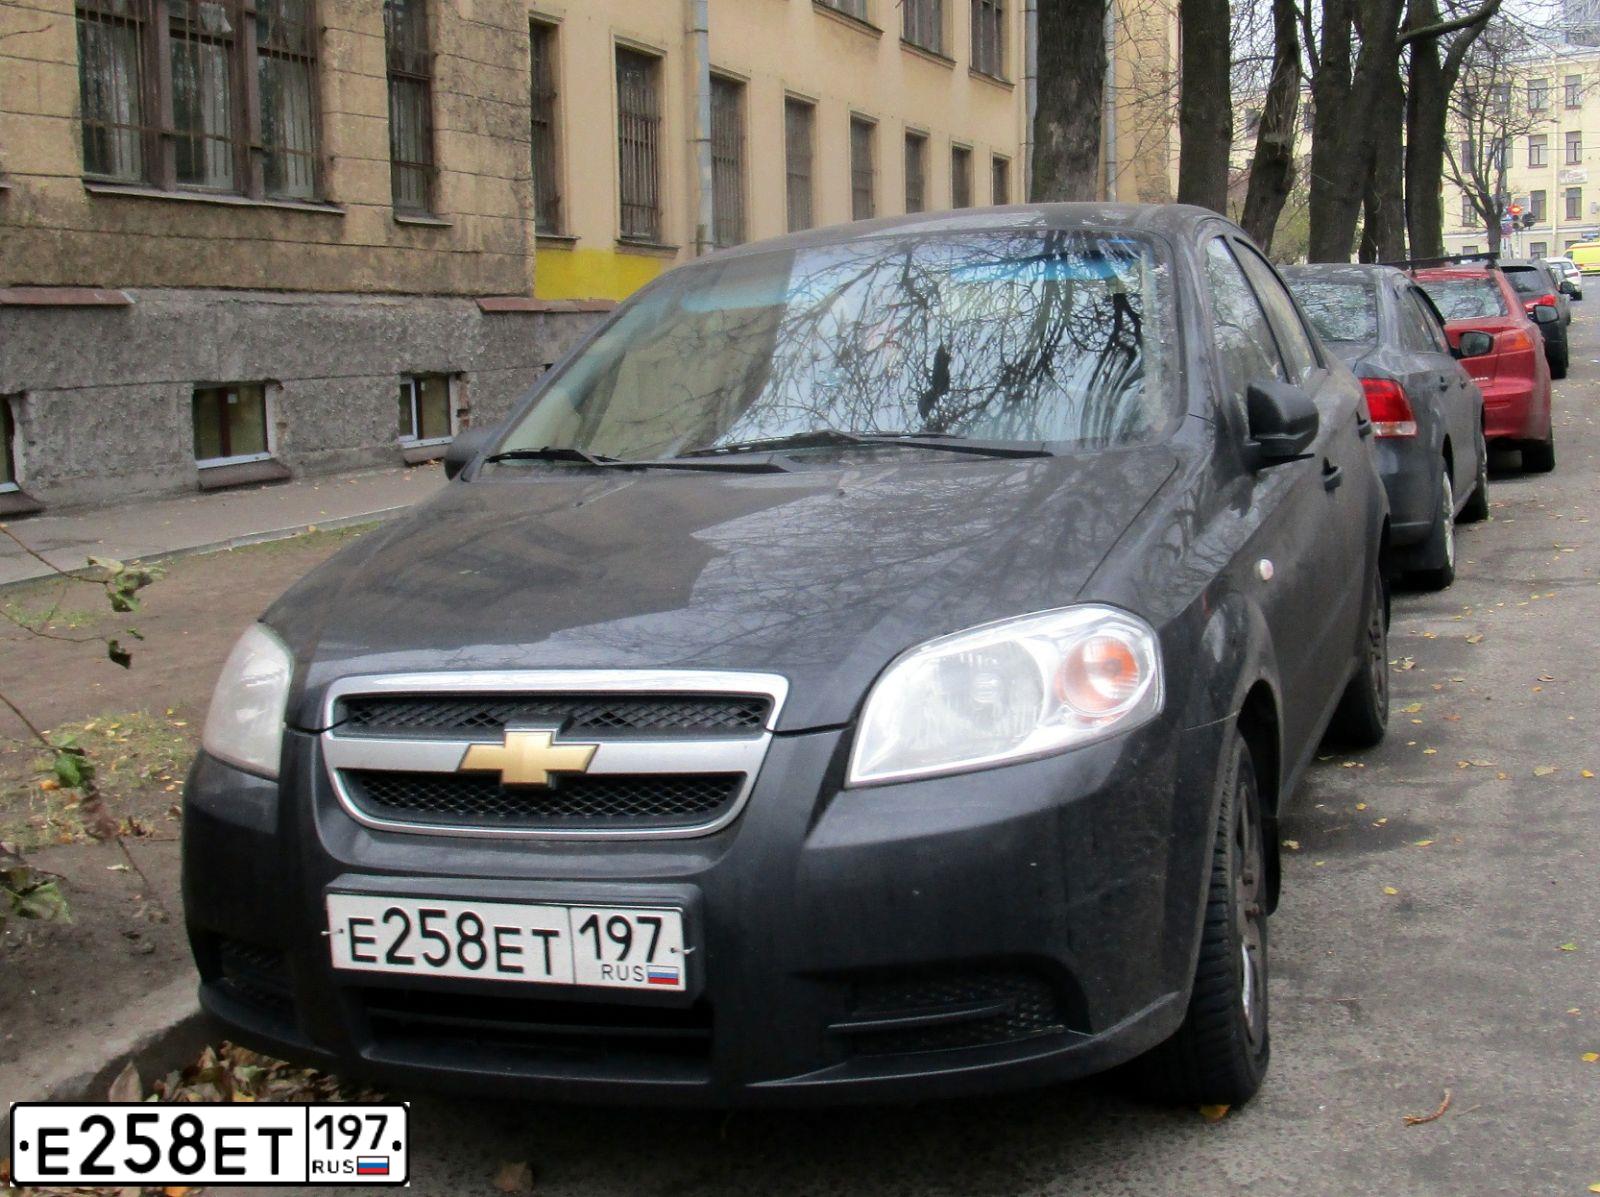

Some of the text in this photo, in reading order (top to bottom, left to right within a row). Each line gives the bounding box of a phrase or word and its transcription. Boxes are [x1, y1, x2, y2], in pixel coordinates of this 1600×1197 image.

[347, 906, 664, 976] E258ET 197
[600, 964, 645, 982] RUS
